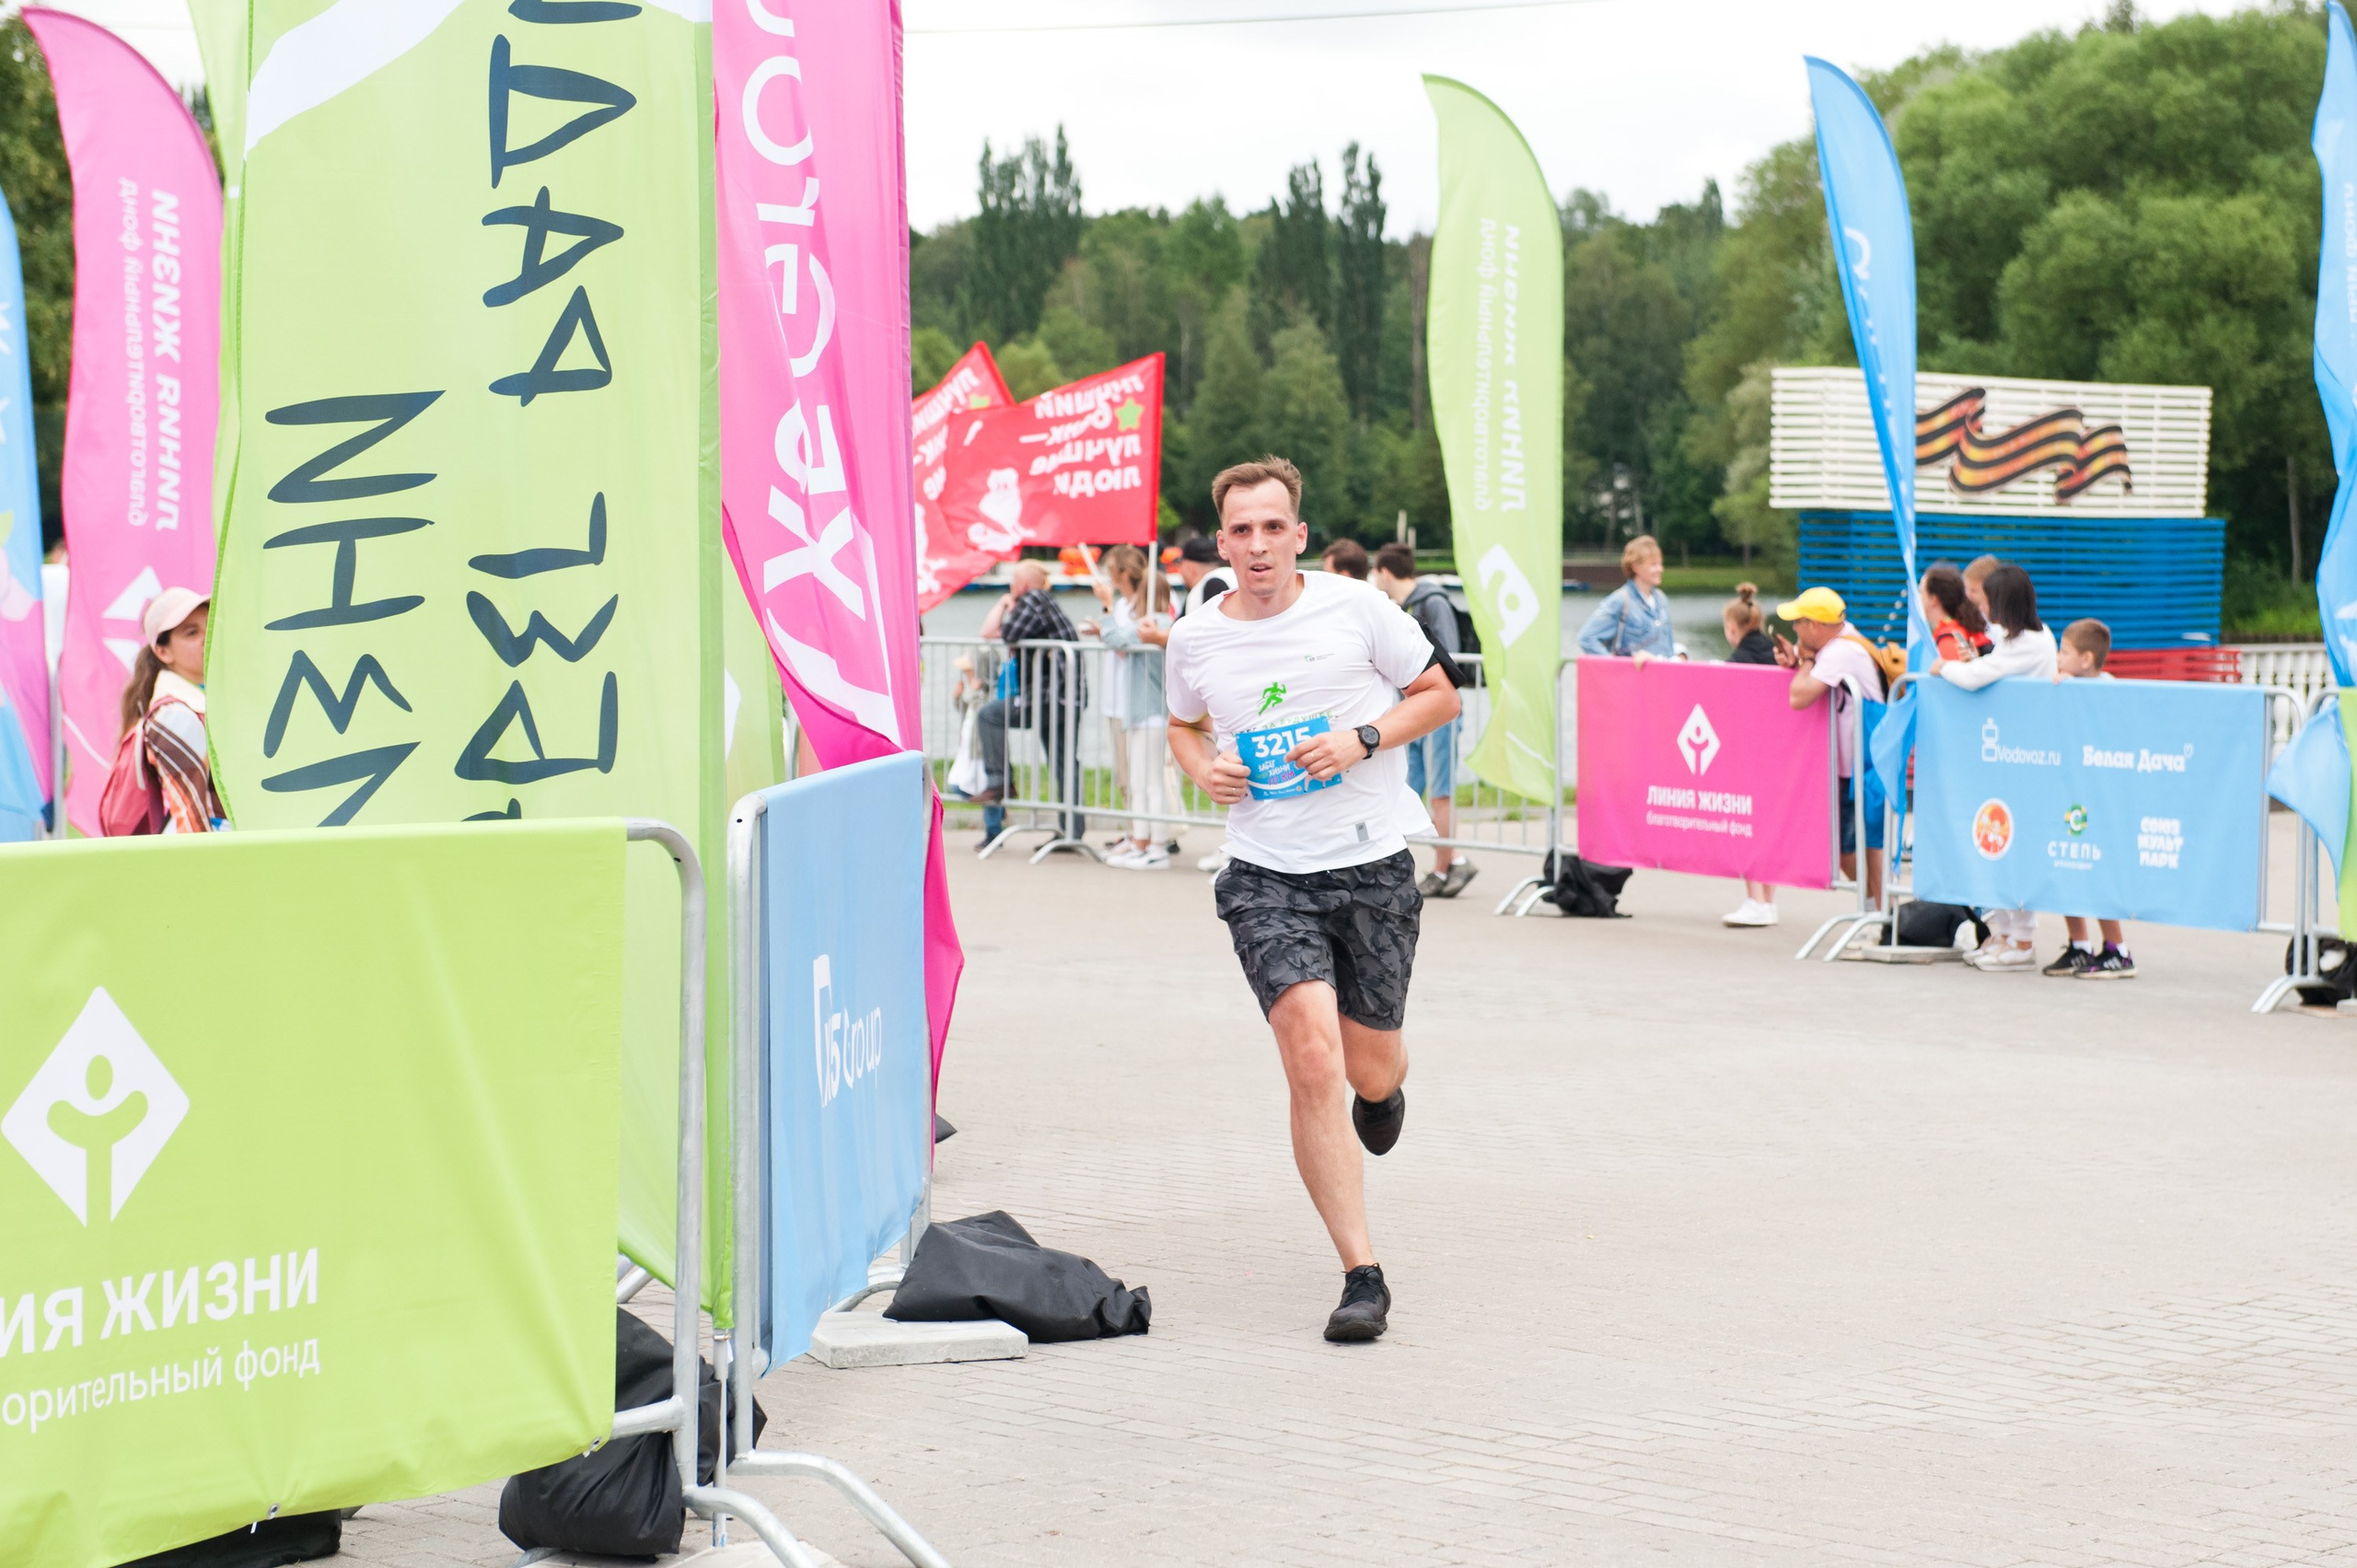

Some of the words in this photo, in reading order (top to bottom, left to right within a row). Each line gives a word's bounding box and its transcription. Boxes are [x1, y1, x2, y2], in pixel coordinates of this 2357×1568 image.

[1251, 726, 1312, 758] 3215
[1997, 745, 2061, 766] Vodovoz.ru
[2083, 745, 2134, 769] Белая
[2137, 749, 2186, 773] Дача
[1646, 785, 1695, 809] ЛИНИЯ
[1698, 790, 1752, 816] ЖИЗНИ
[2048, 840, 2102, 861] СТЕПЬ
[2139, 851, 2179, 869] ПАРК
[99, 1247, 319, 1341] ЖИЗНИ
[234, 1338, 320, 1393] фонд
